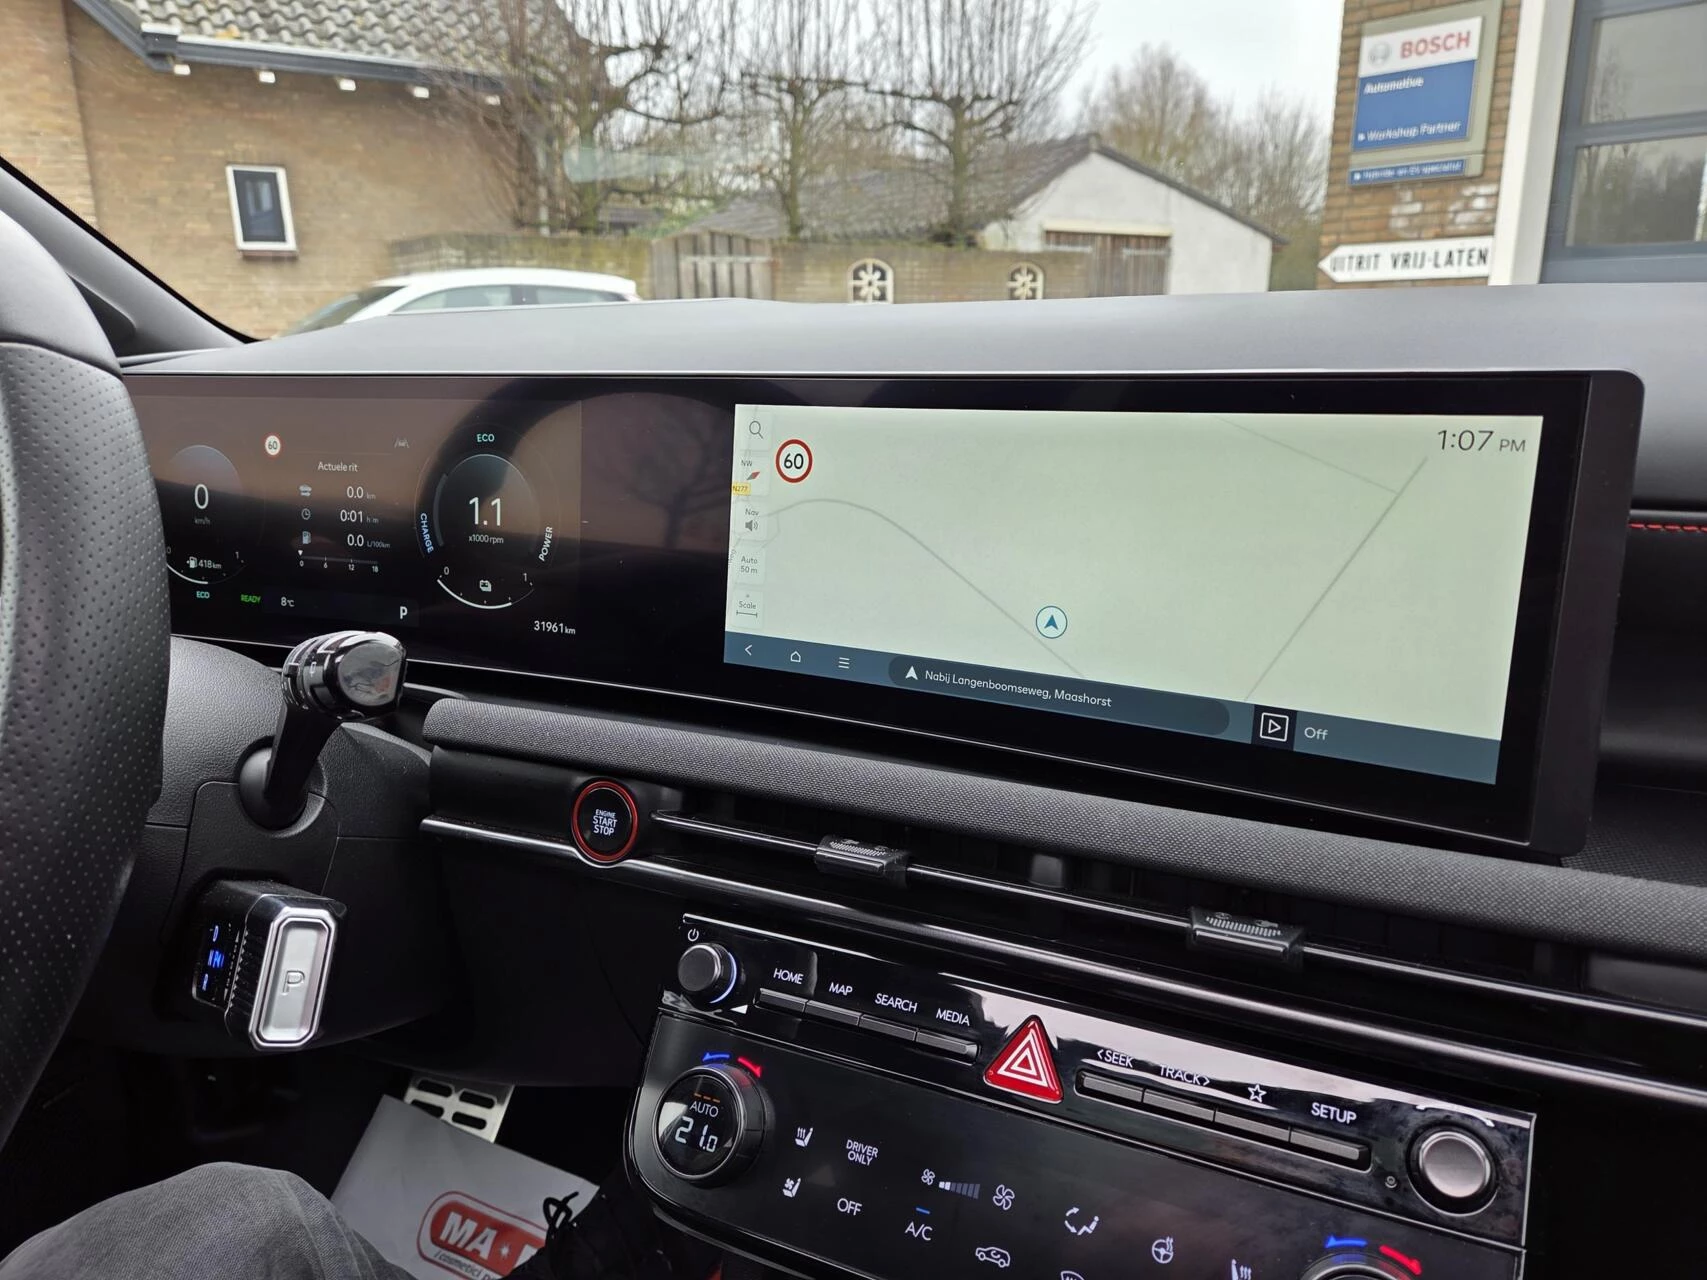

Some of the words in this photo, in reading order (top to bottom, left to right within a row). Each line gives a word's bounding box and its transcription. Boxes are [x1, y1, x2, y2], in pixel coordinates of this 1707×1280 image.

[1400, 31, 1471, 60] BOSCH
[1364, 75, 1424, 95] Automotive
[268, 440, 278, 450] 60
[476, 433, 495, 443] ECO
[1437, 429, 1495, 452] 1:07
[1499, 438, 1526, 453] PM
[317, 461, 348, 473] Actuele
[348, 462, 359, 473] rit
[741, 459, 753, 468] NW
[783, 453, 804, 470] 60
[194, 483, 209, 510] 0
[346, 486, 364, 499] 0.0
[340, 509, 364, 524] 0:01
[468, 496, 502, 527] 1.1
[745, 508, 759, 517] Nav
[347, 533, 365, 547] 0.0
[420, 512, 434, 554] CHARGE
[538, 526, 553, 562] POWER
[740, 556, 758, 564] Auto
[443, 566, 450, 575] 0
[740, 565, 750, 574] 50
[196, 591, 210, 599] ECO
[240, 594, 261, 604] READY
[399, 606, 408, 620] P
[738, 601, 757, 610] Scale
[925, 670, 950, 684] Nabij
[952, 674, 1051, 699] Langenboomseweg,
[1054, 689, 1112, 708] Maashorst
[1304, 726, 1329, 740] Off
[593, 815, 617, 827] START
[595, 809, 616, 818] ENGINE
[593, 825, 614, 835] STOP
[281, 969, 306, 996] P
[773, 967, 804, 985] HOME
[828, 981, 854, 996] MAP
[875, 992, 918, 1014] SEARCH
[936, 1007, 970, 1027] MEDIA
[689, 1100, 719, 1118] AUTO
[1311, 1102, 1357, 1125] SETUP
[845, 1139, 879, 1159] DRIVER
[847, 1151, 874, 1167] ONLY
[836, 1198, 863, 1216] OFF
[904, 1221, 933, 1242] A/C
